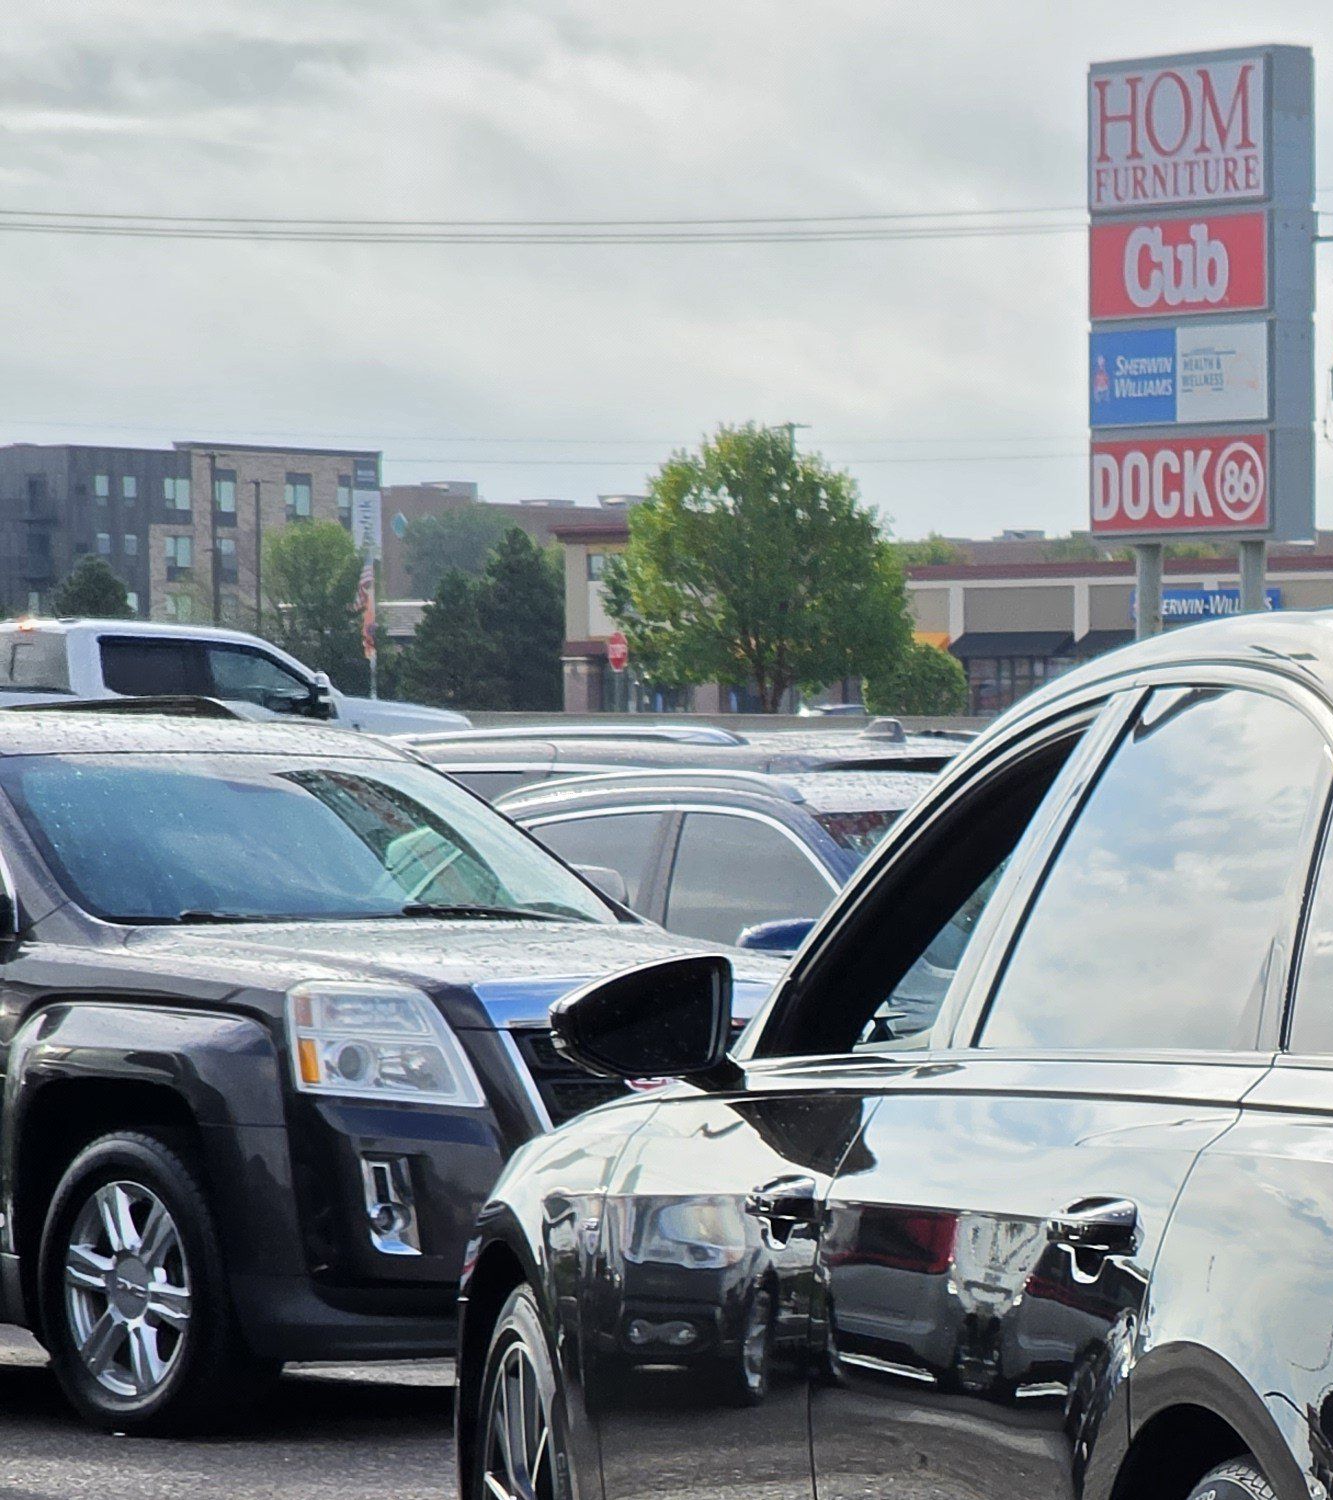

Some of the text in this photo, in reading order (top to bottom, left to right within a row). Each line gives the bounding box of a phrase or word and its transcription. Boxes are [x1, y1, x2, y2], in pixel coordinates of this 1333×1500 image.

[1094, 64, 1257, 163] HOM
[1094, 154, 1260, 203] FURNITURE
[1124, 222, 1229, 308] Cub
[1115, 355, 1172, 376] SHERWIN
[1115, 378, 1173, 398] WILLIAMS
[1093, 449, 1256, 521] DOCK 86
